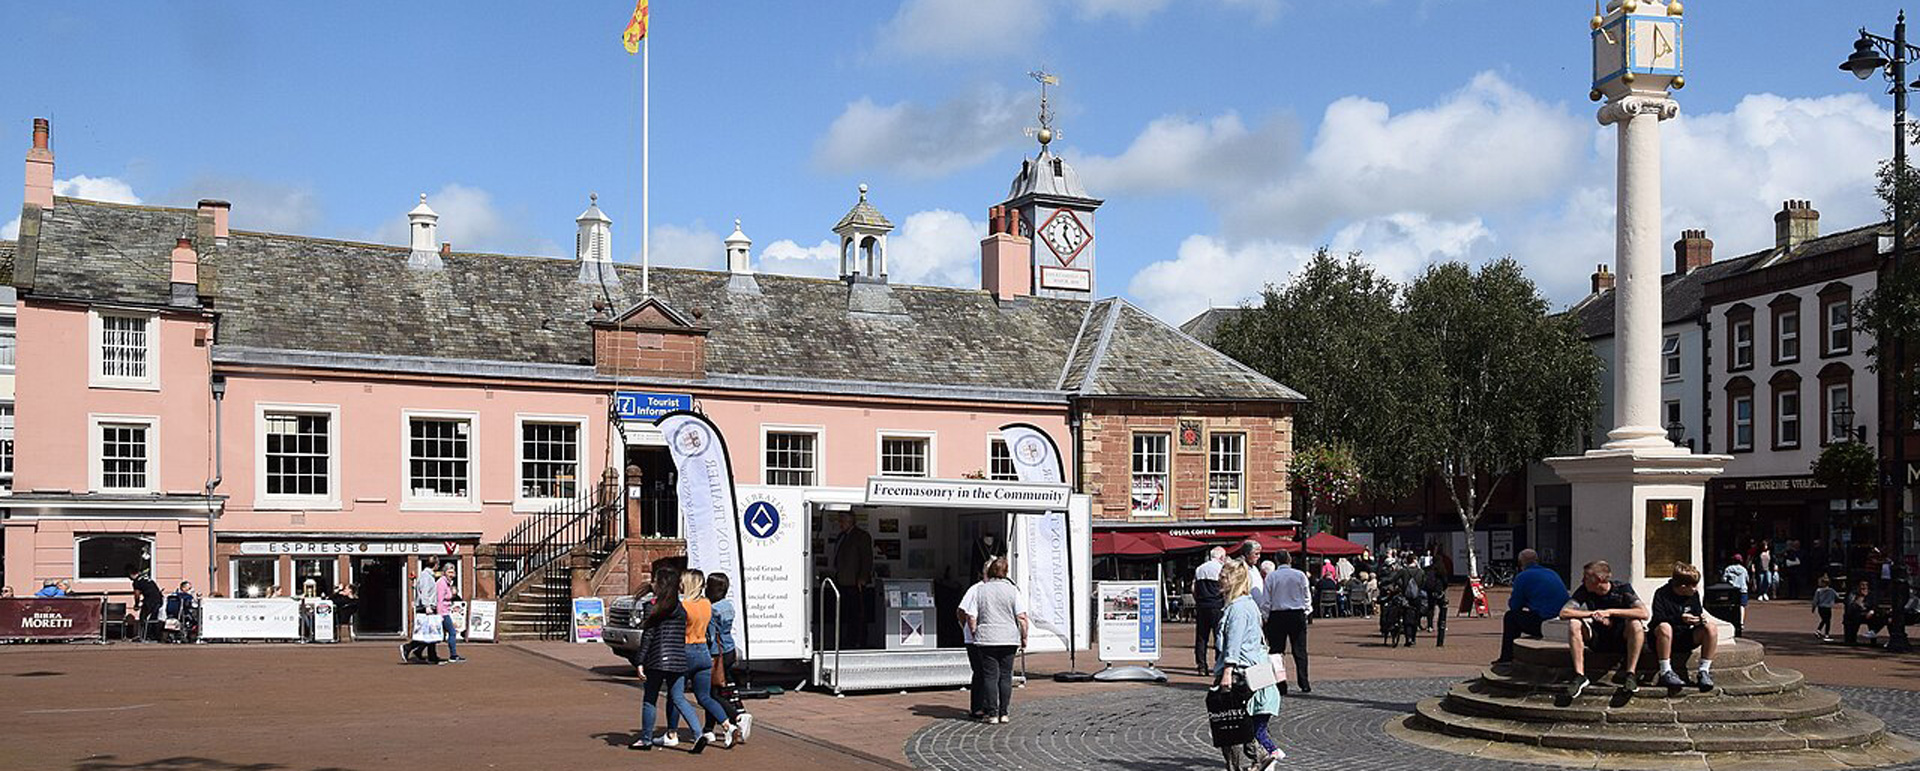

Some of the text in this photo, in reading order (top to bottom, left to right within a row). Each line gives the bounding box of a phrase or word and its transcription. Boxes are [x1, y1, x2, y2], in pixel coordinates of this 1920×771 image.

[647, 397, 680, 407] Tourist
[637, 406, 679, 416] Inform
[873, 483, 1065, 504] Freemasonry in the Community
[385, 542, 420, 552] HUB
[21, 617, 72, 628] MORETTI
